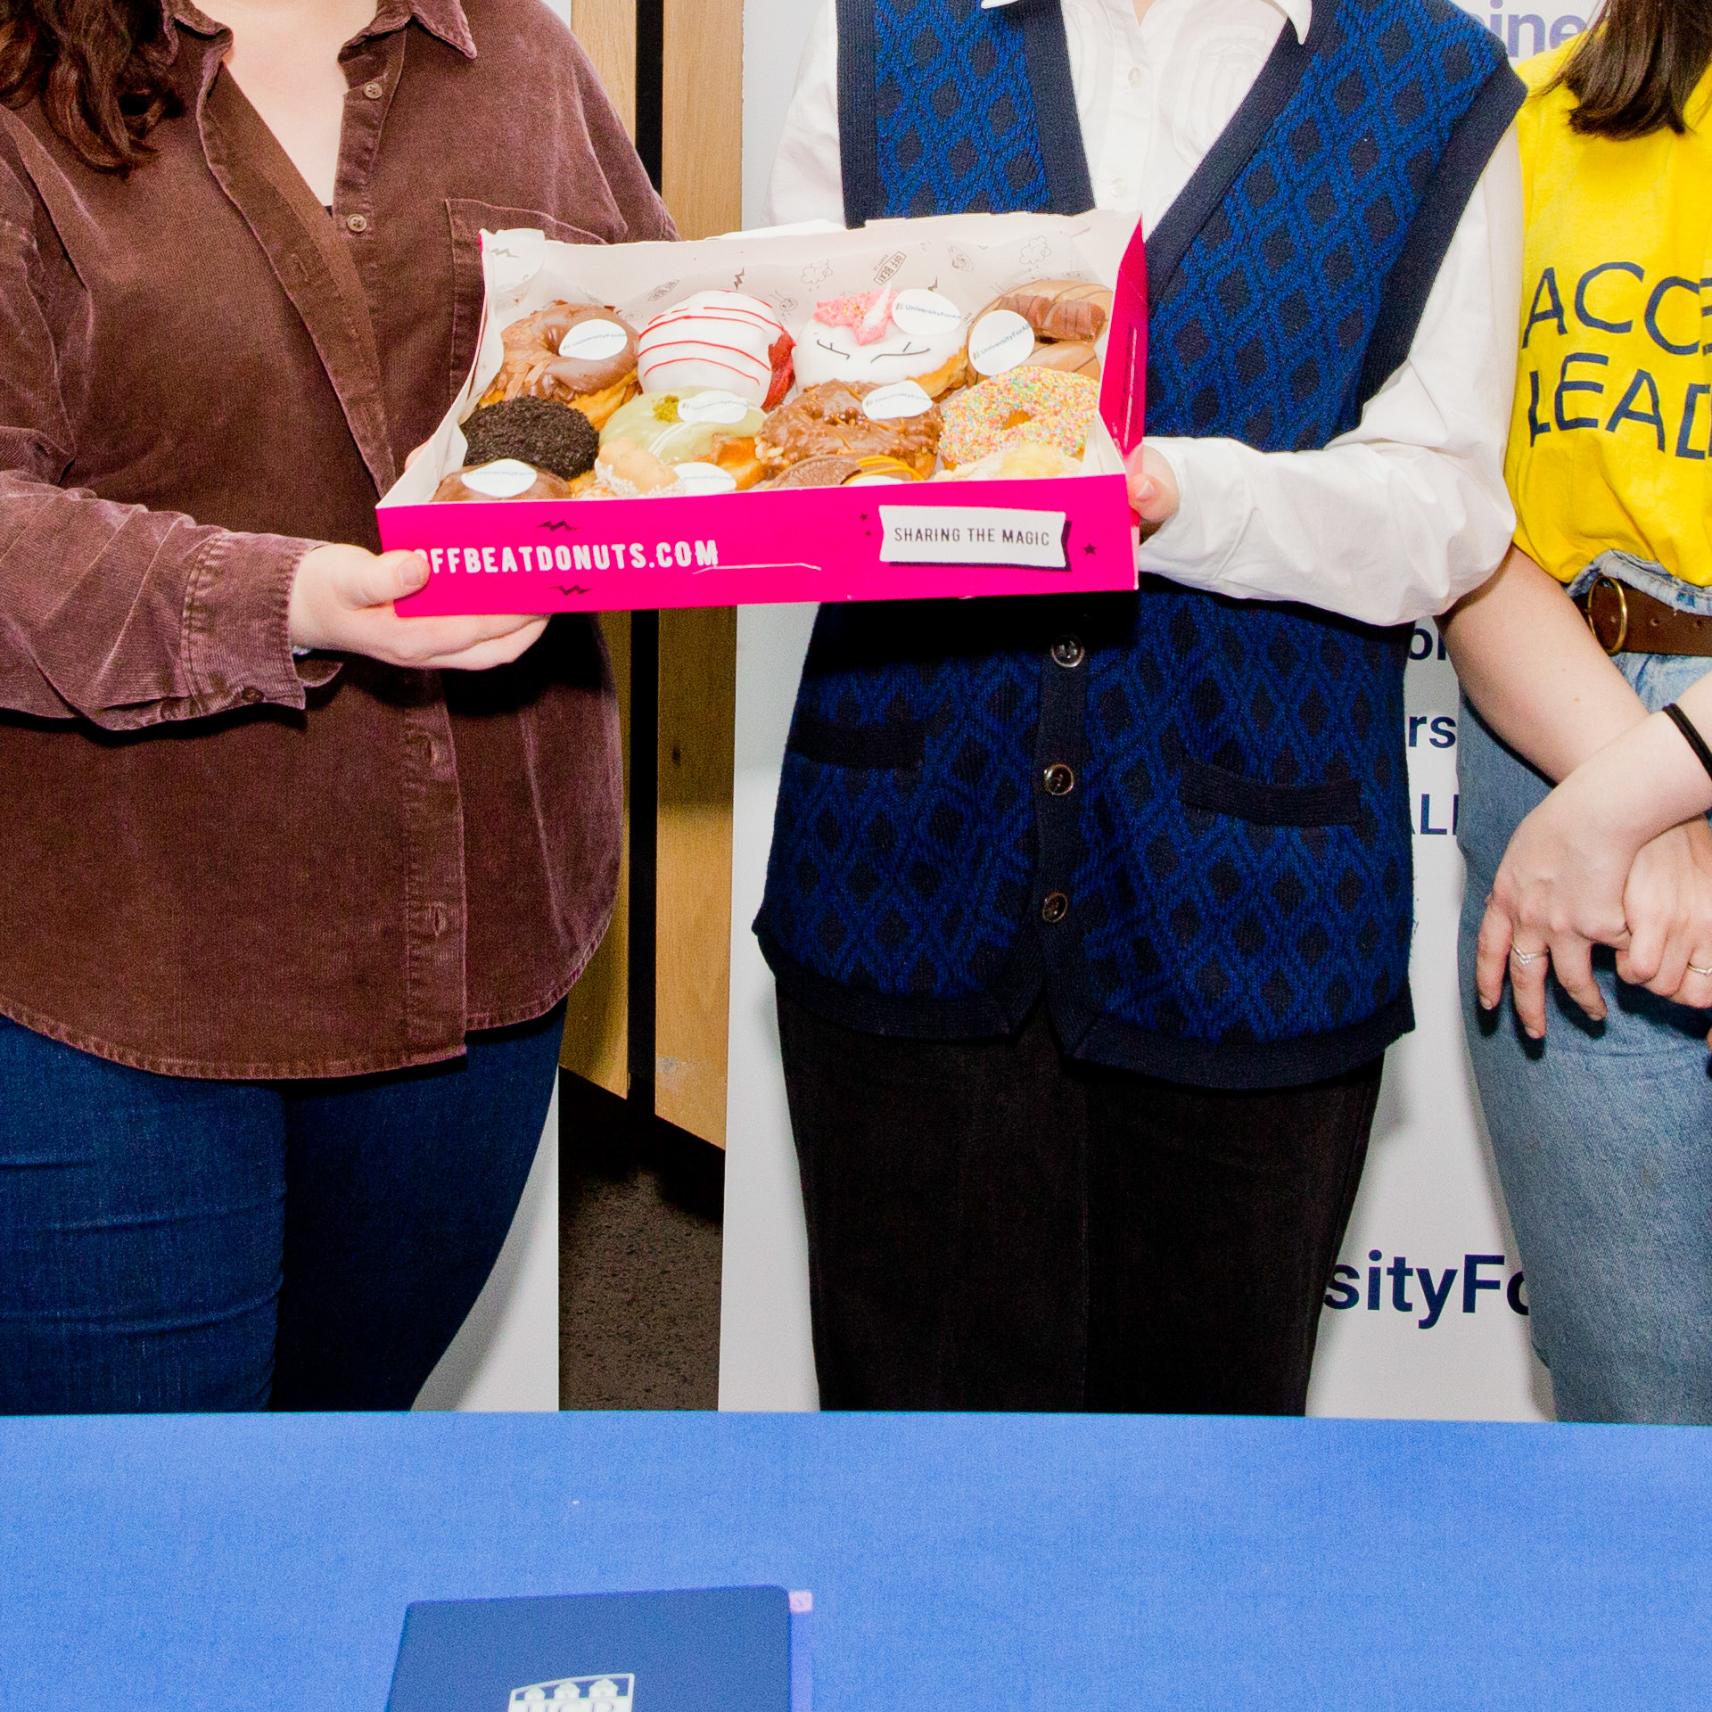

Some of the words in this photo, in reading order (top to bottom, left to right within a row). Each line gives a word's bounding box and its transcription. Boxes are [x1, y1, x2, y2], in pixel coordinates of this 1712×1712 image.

[895, 528, 960, 541] SHARING
[968, 528, 994, 542] THE
[1002, 530, 1048, 545] MAGIC
